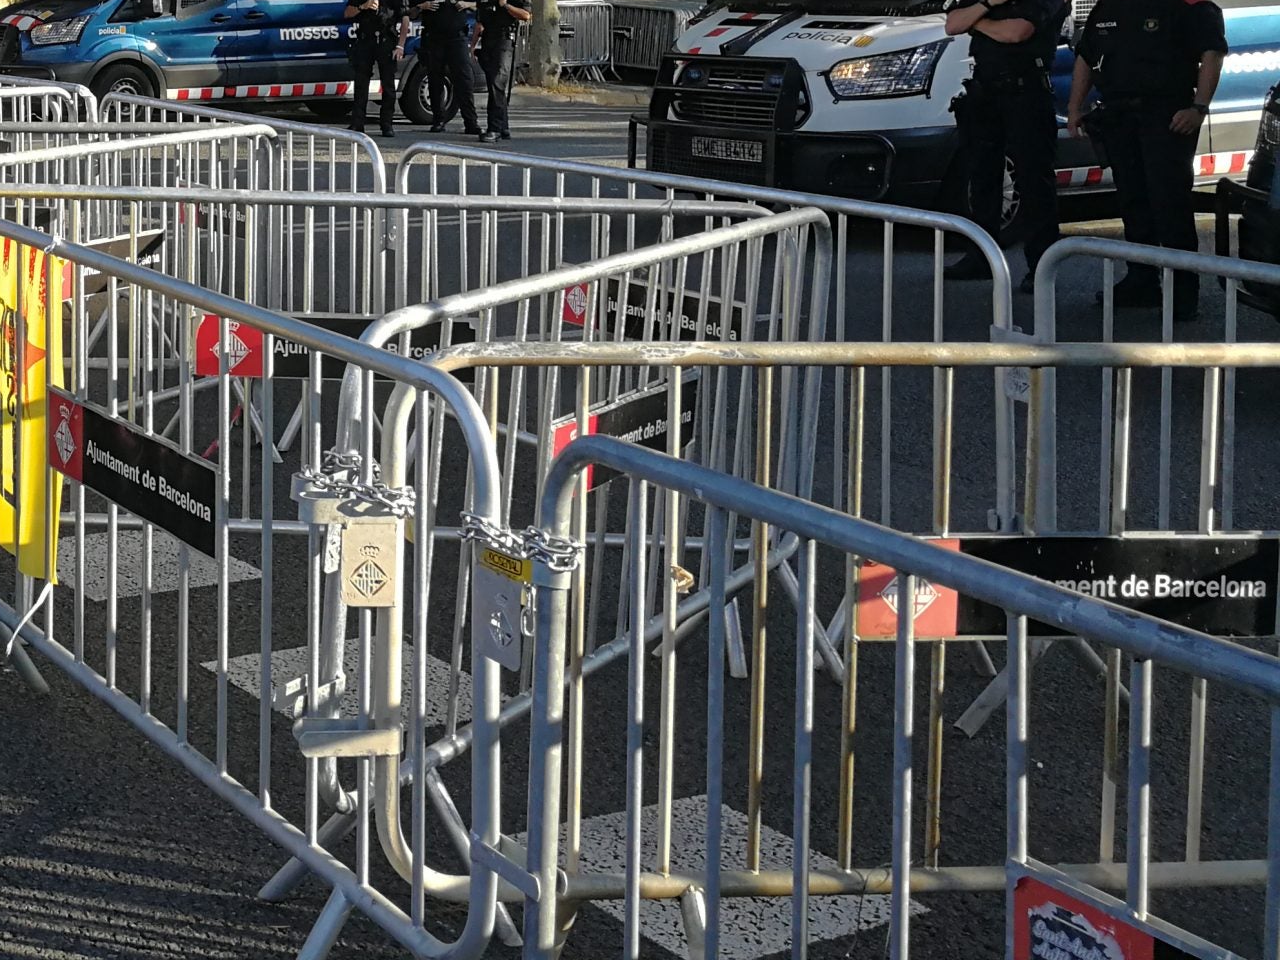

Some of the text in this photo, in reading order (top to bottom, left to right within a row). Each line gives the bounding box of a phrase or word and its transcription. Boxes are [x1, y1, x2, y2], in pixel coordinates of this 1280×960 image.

[98, 26, 121, 36] policia
[280, 25, 340, 40] mossos
[782, 30, 853, 44] policia
[644, 422, 655, 439] de
[86, 439, 211, 522] Ajuntament de Barcelona
[1121, 574, 1149, 598] de
[1154, 574, 1267, 598] Barcelona
